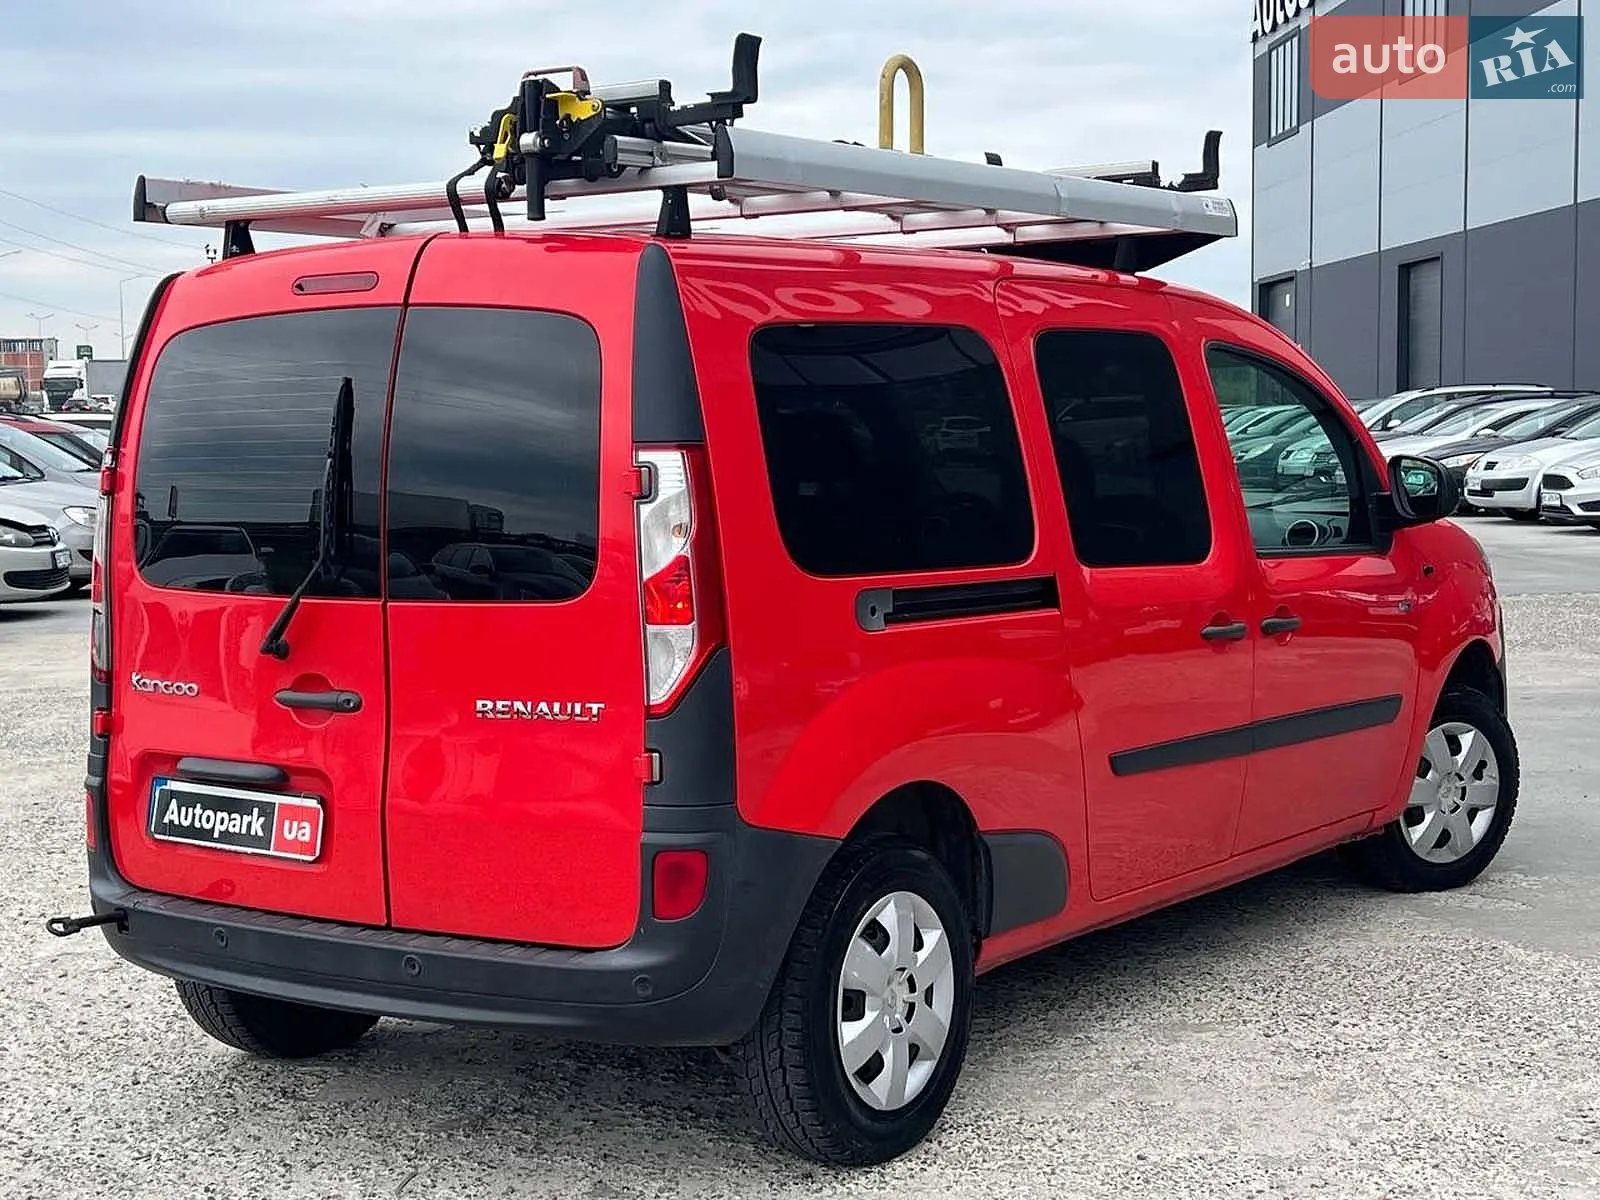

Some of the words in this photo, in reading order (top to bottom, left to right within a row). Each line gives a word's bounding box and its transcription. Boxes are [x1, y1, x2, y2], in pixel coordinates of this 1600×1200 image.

[475, 699, 605, 722] RENAULT
[162, 798, 265, 838] Autopark
[283, 819, 311, 842] ua
